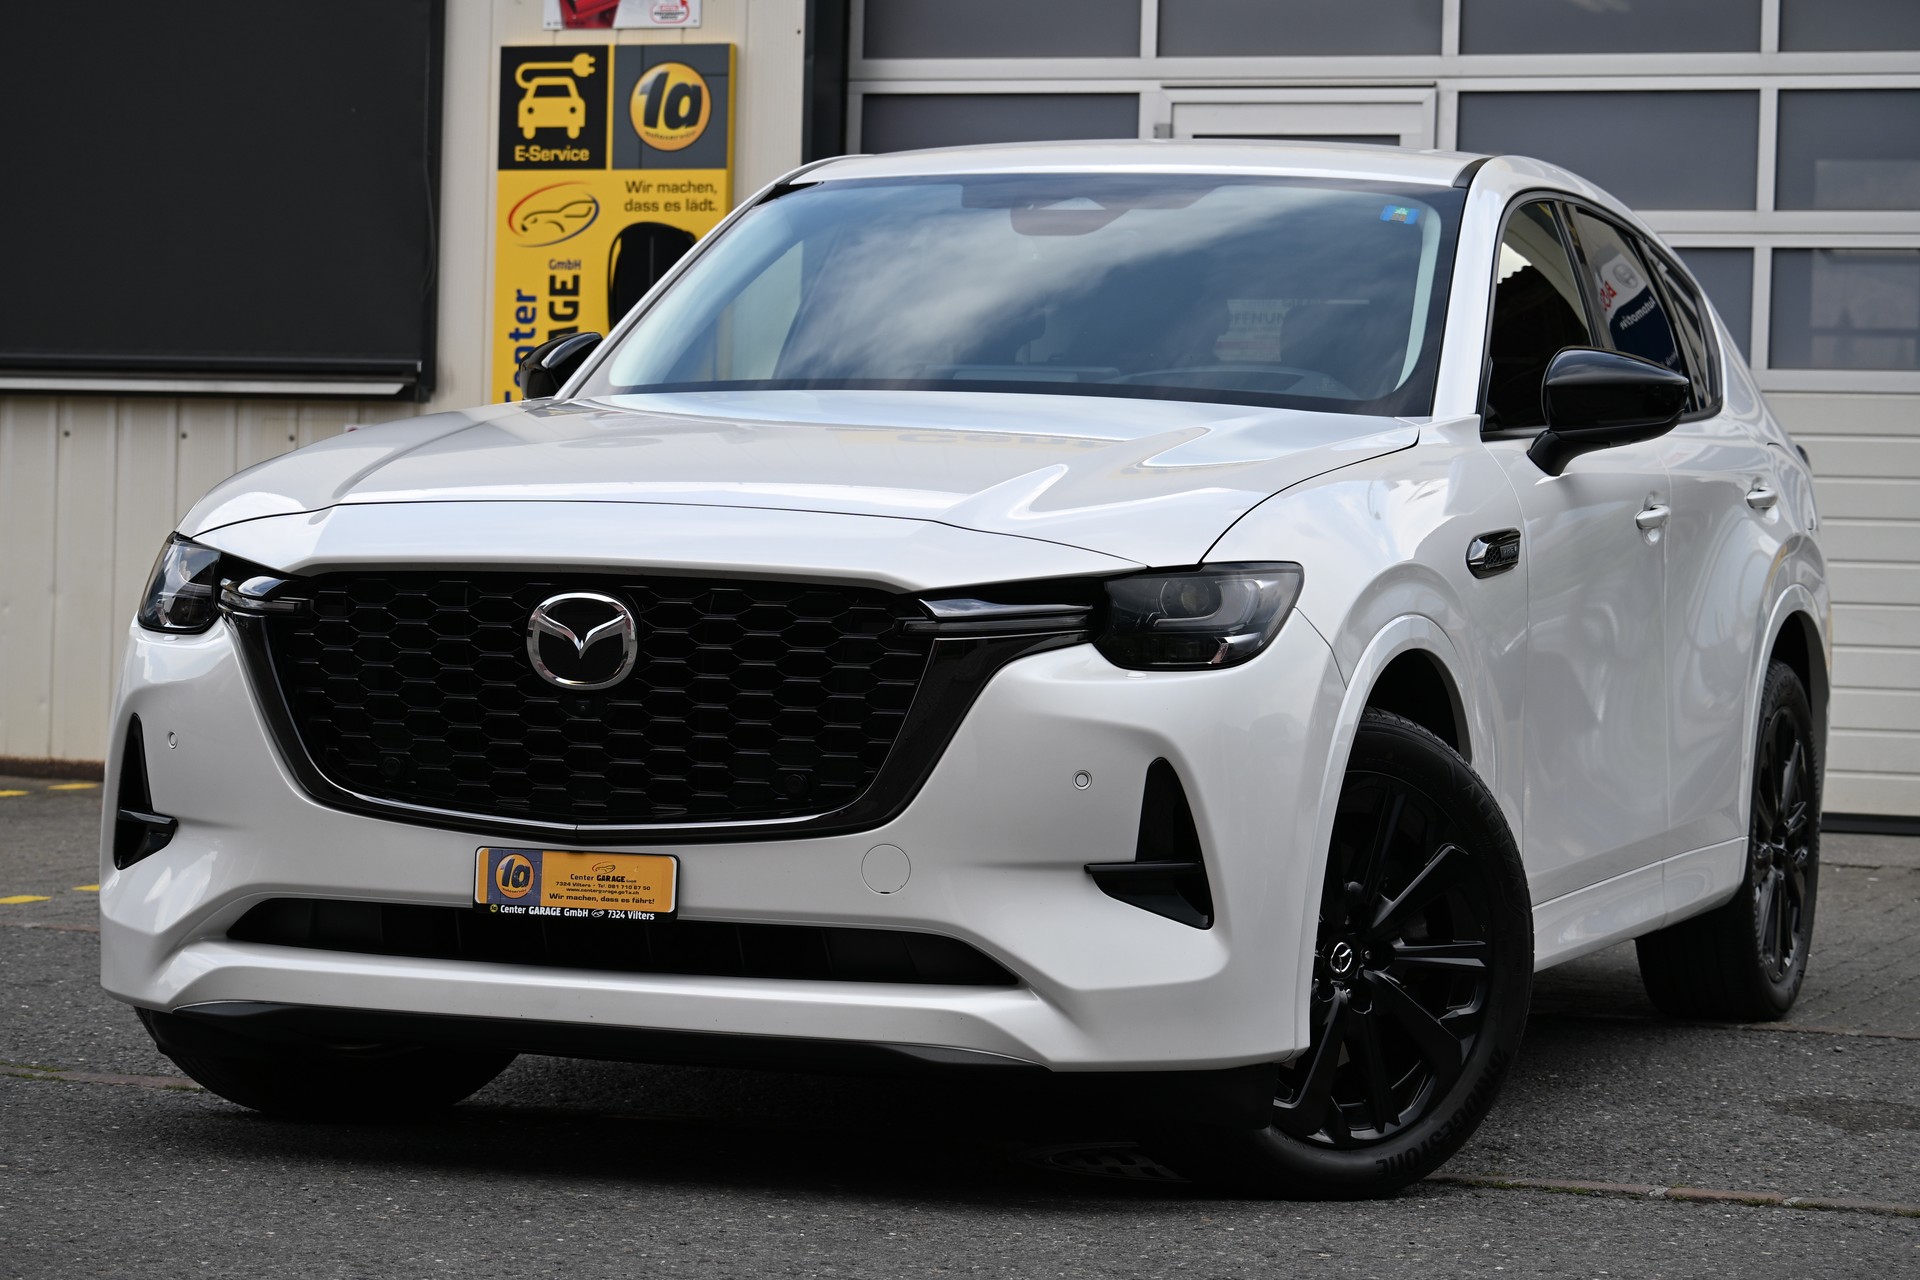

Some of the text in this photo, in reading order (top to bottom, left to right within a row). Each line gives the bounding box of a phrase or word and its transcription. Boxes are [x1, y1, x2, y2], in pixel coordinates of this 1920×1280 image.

[639, 71, 703, 131] 1a
[514, 145, 590, 162] E-Service
[625, 181, 718, 196] Wir machen,
[624, 199, 718, 212] dass es lädt.
[548, 259, 582, 270] GmbH
[501, 858, 531, 889] 1a
[570, 873, 594, 881] Center
[596, 874, 626, 883] GARAGE
[566, 894, 599, 903] machen,
[600, 895, 619, 903] dass
[500, 904, 526, 915] Center
[528, 906, 561, 916] GARAGE
[563, 908, 589, 918] GmbH
[608, 910, 626, 919] 7324
[627, 911, 655, 921] Vilters
